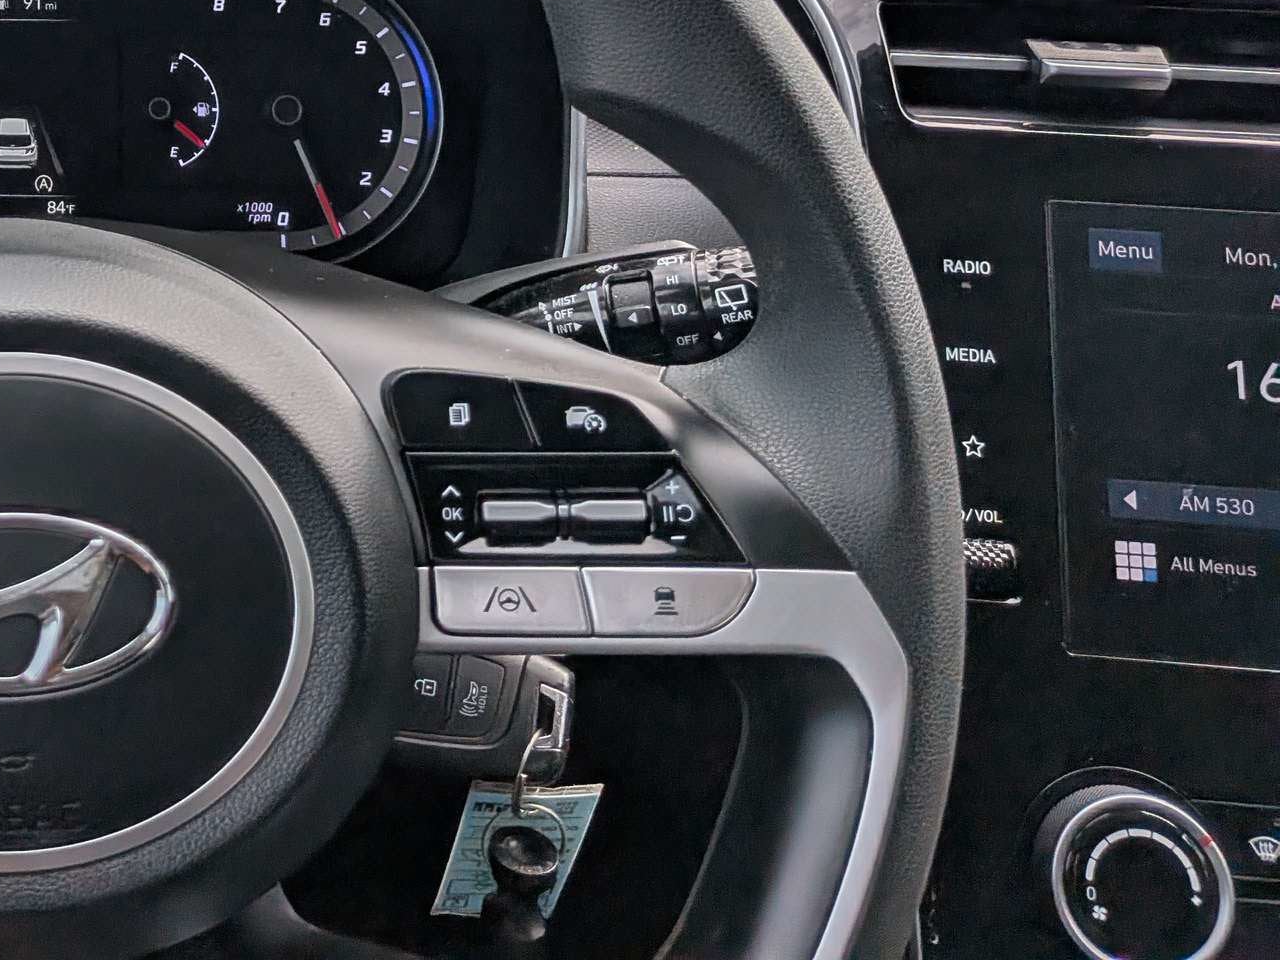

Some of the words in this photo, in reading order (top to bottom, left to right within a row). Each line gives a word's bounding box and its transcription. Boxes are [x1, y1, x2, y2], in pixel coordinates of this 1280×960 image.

[44, 1, 57, 11] mi
[275, 0, 287, 14] 7
[319, 12, 332, 27] 6
[354, 40, 368, 55] 5
[169, 61, 179, 73] F
[377, 82, 391, 97] 4
[379, 128, 393, 144] 3
[169, 146, 180, 158] E
[359, 171, 372, 186] 2
[248, 213, 272, 225] rpm
[276, 211, 290, 227] 0
[1098, 240, 1153, 260] Menu
[1225, 246, 1278, 269] Mon,
[943, 258, 991, 275] RADIO
[665, 274, 680, 286] HI
[552, 293, 578, 308] MIST
[554, 307, 575, 320] OFF
[670, 302, 688, 316] LO
[720, 308, 754, 325] REAR
[557, 323, 573, 334] INT
[676, 333, 699, 346] OFF
[945, 346, 997, 364] MEDIA
[1178, 495, 1211, 516] AM
[1216, 497, 1255, 516] 530
[441, 506, 463, 521] OK
[1170, 556, 1195, 573] All
[1199, 558, 1257, 577] Menus
[478, 685, 489, 713] HOLD
